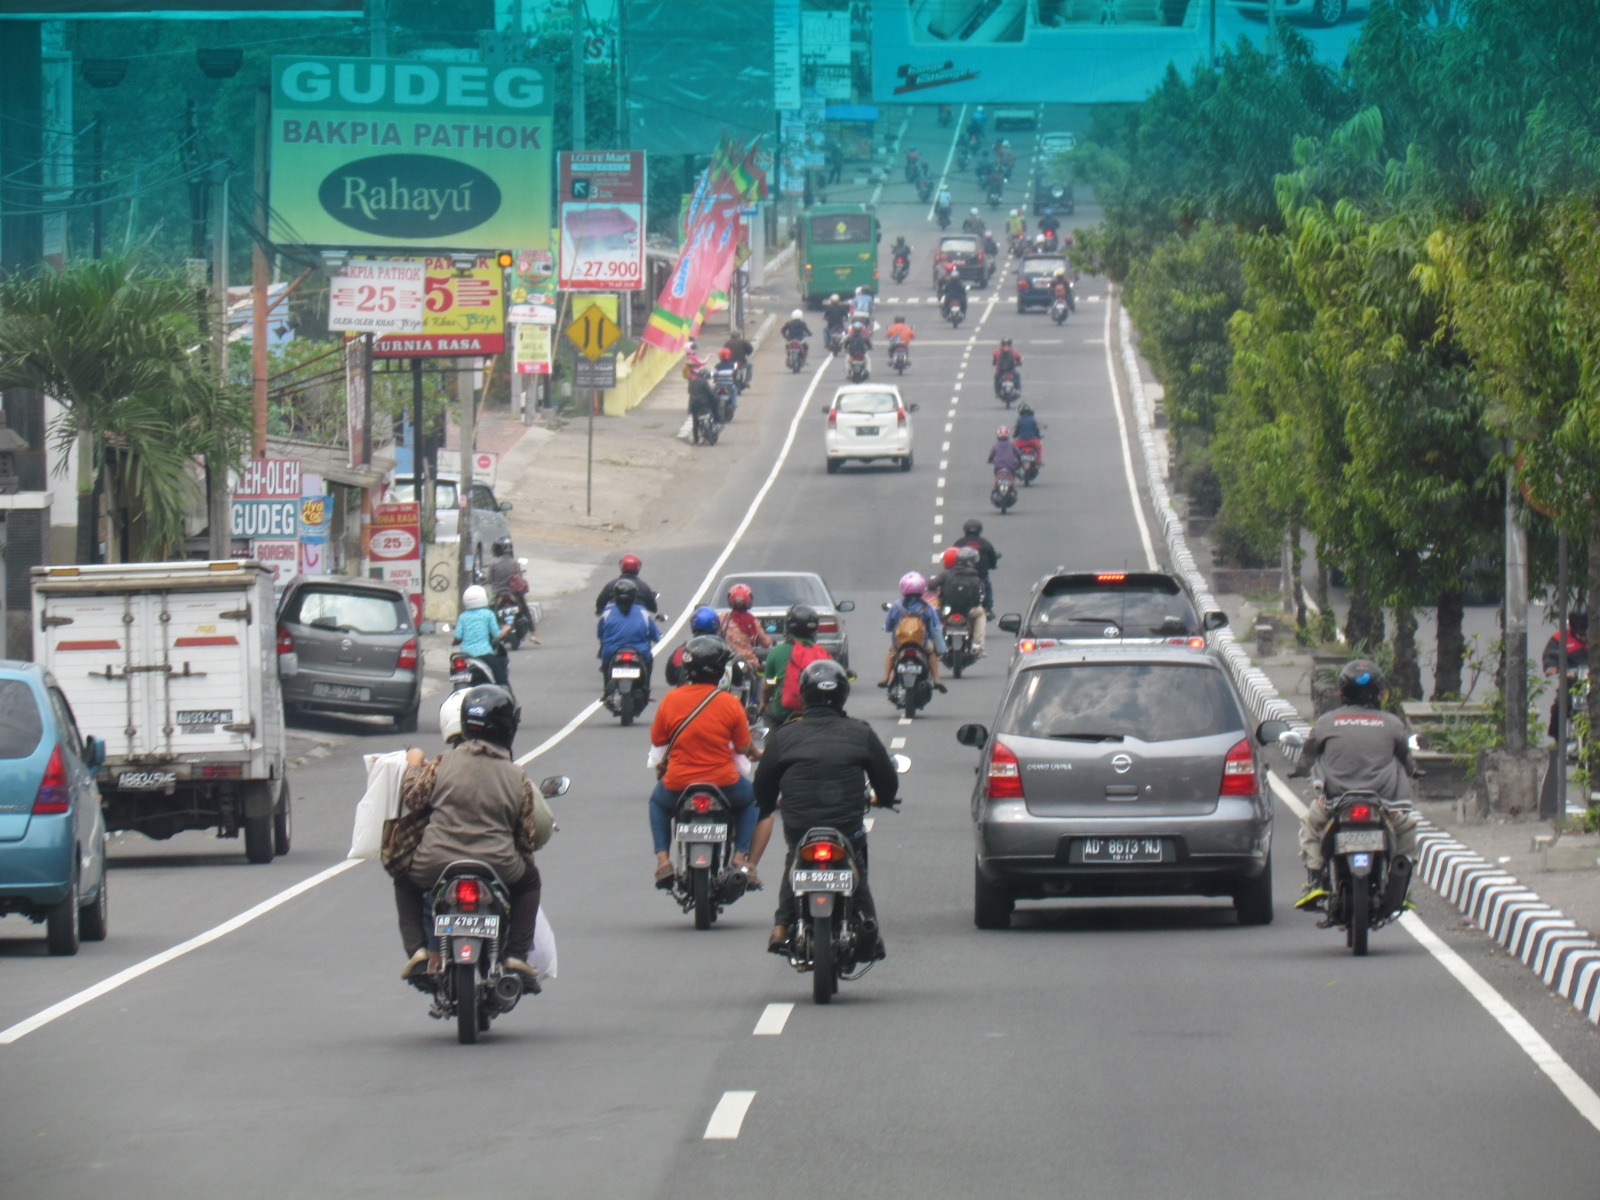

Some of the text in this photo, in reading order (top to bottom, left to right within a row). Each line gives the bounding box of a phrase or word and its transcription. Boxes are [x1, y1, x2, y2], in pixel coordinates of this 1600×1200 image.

[281, 61, 544, 108] GUDEG
[282, 119, 543, 151] BAKPIA PATHOK
[571, 153, 631, 162] LOTTE Mart
[424, 257, 490, 271] PATK
[584, 261, 638, 277] 27.900
[378, 267, 421, 281] PATHOK
[357, 285, 396, 313] 25
[441, 338, 482, 350] RASA
[232, 503, 295, 535] GUDEG
[383, 537, 402, 549] 25
[257, 544, 295, 560] GORENG
[1085, 838, 1161, 854] AD 8673 NJ
